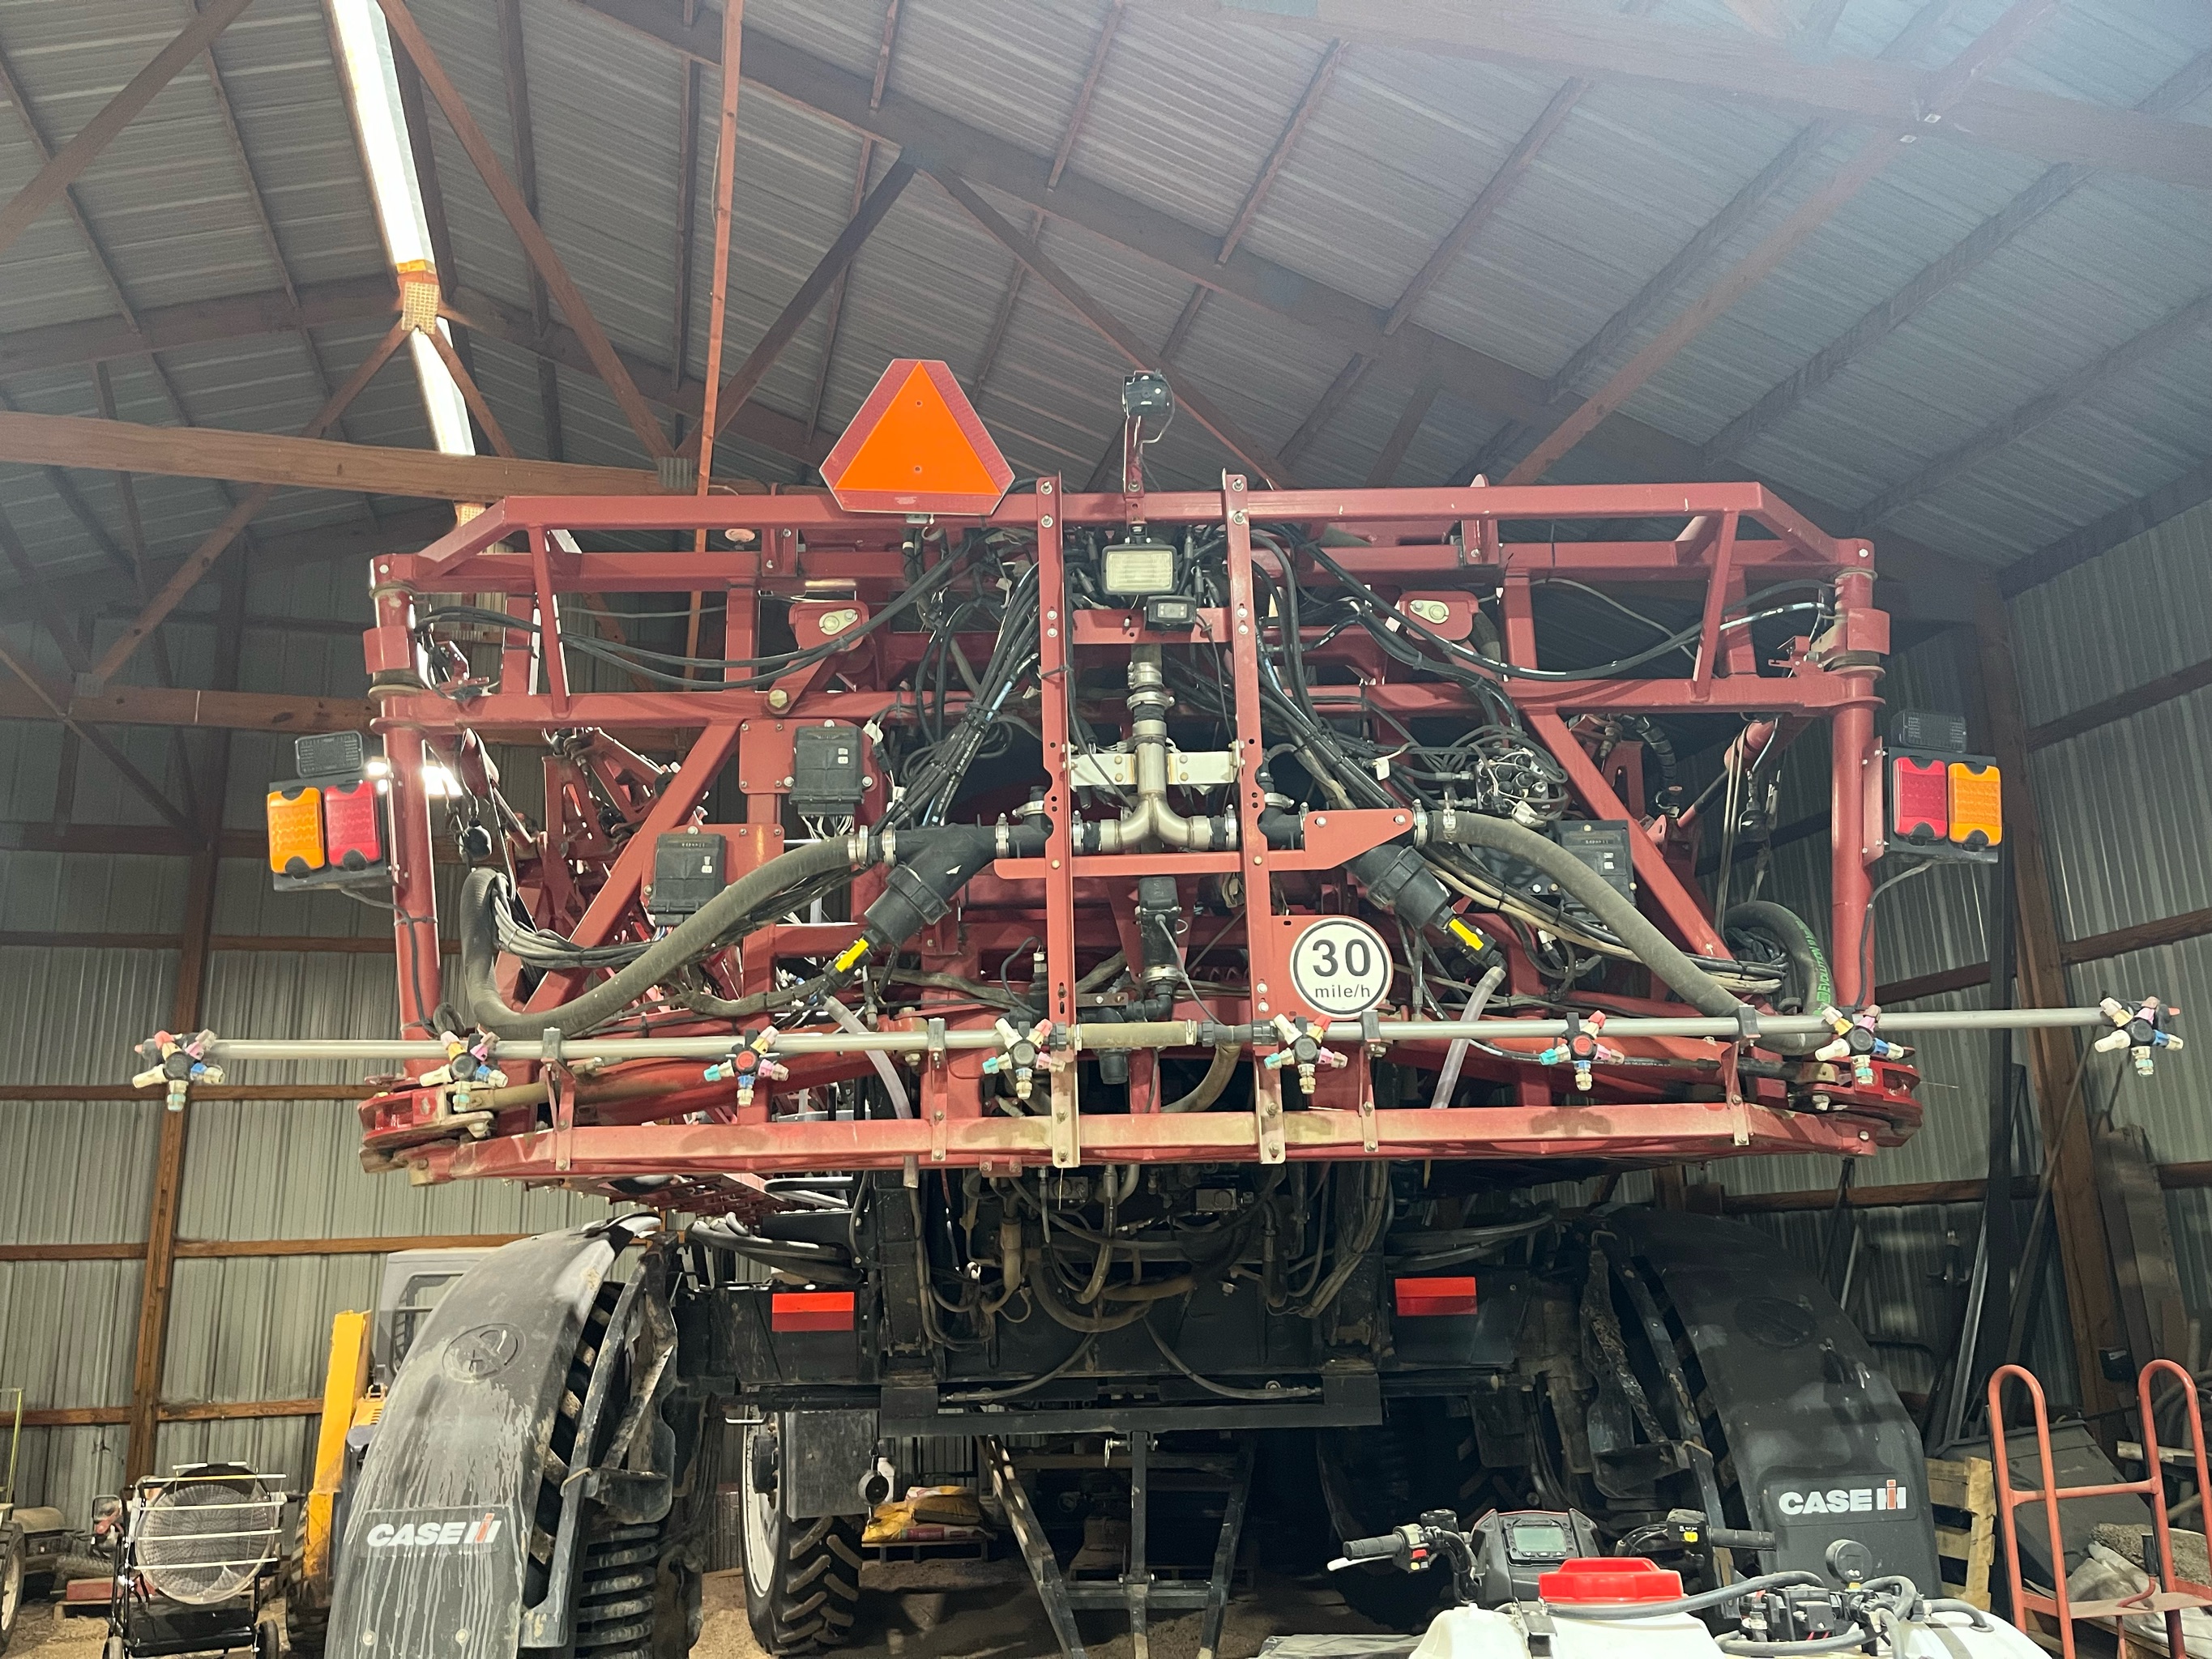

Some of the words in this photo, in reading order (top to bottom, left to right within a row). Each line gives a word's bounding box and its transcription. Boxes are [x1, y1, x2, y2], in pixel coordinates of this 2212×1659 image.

[1313, 939, 1371, 977] 30
[1315, 984, 1370, 998] mile/h
[1779, 1489, 1873, 1515] CASE
[367, 1521, 467, 1547] CASE
